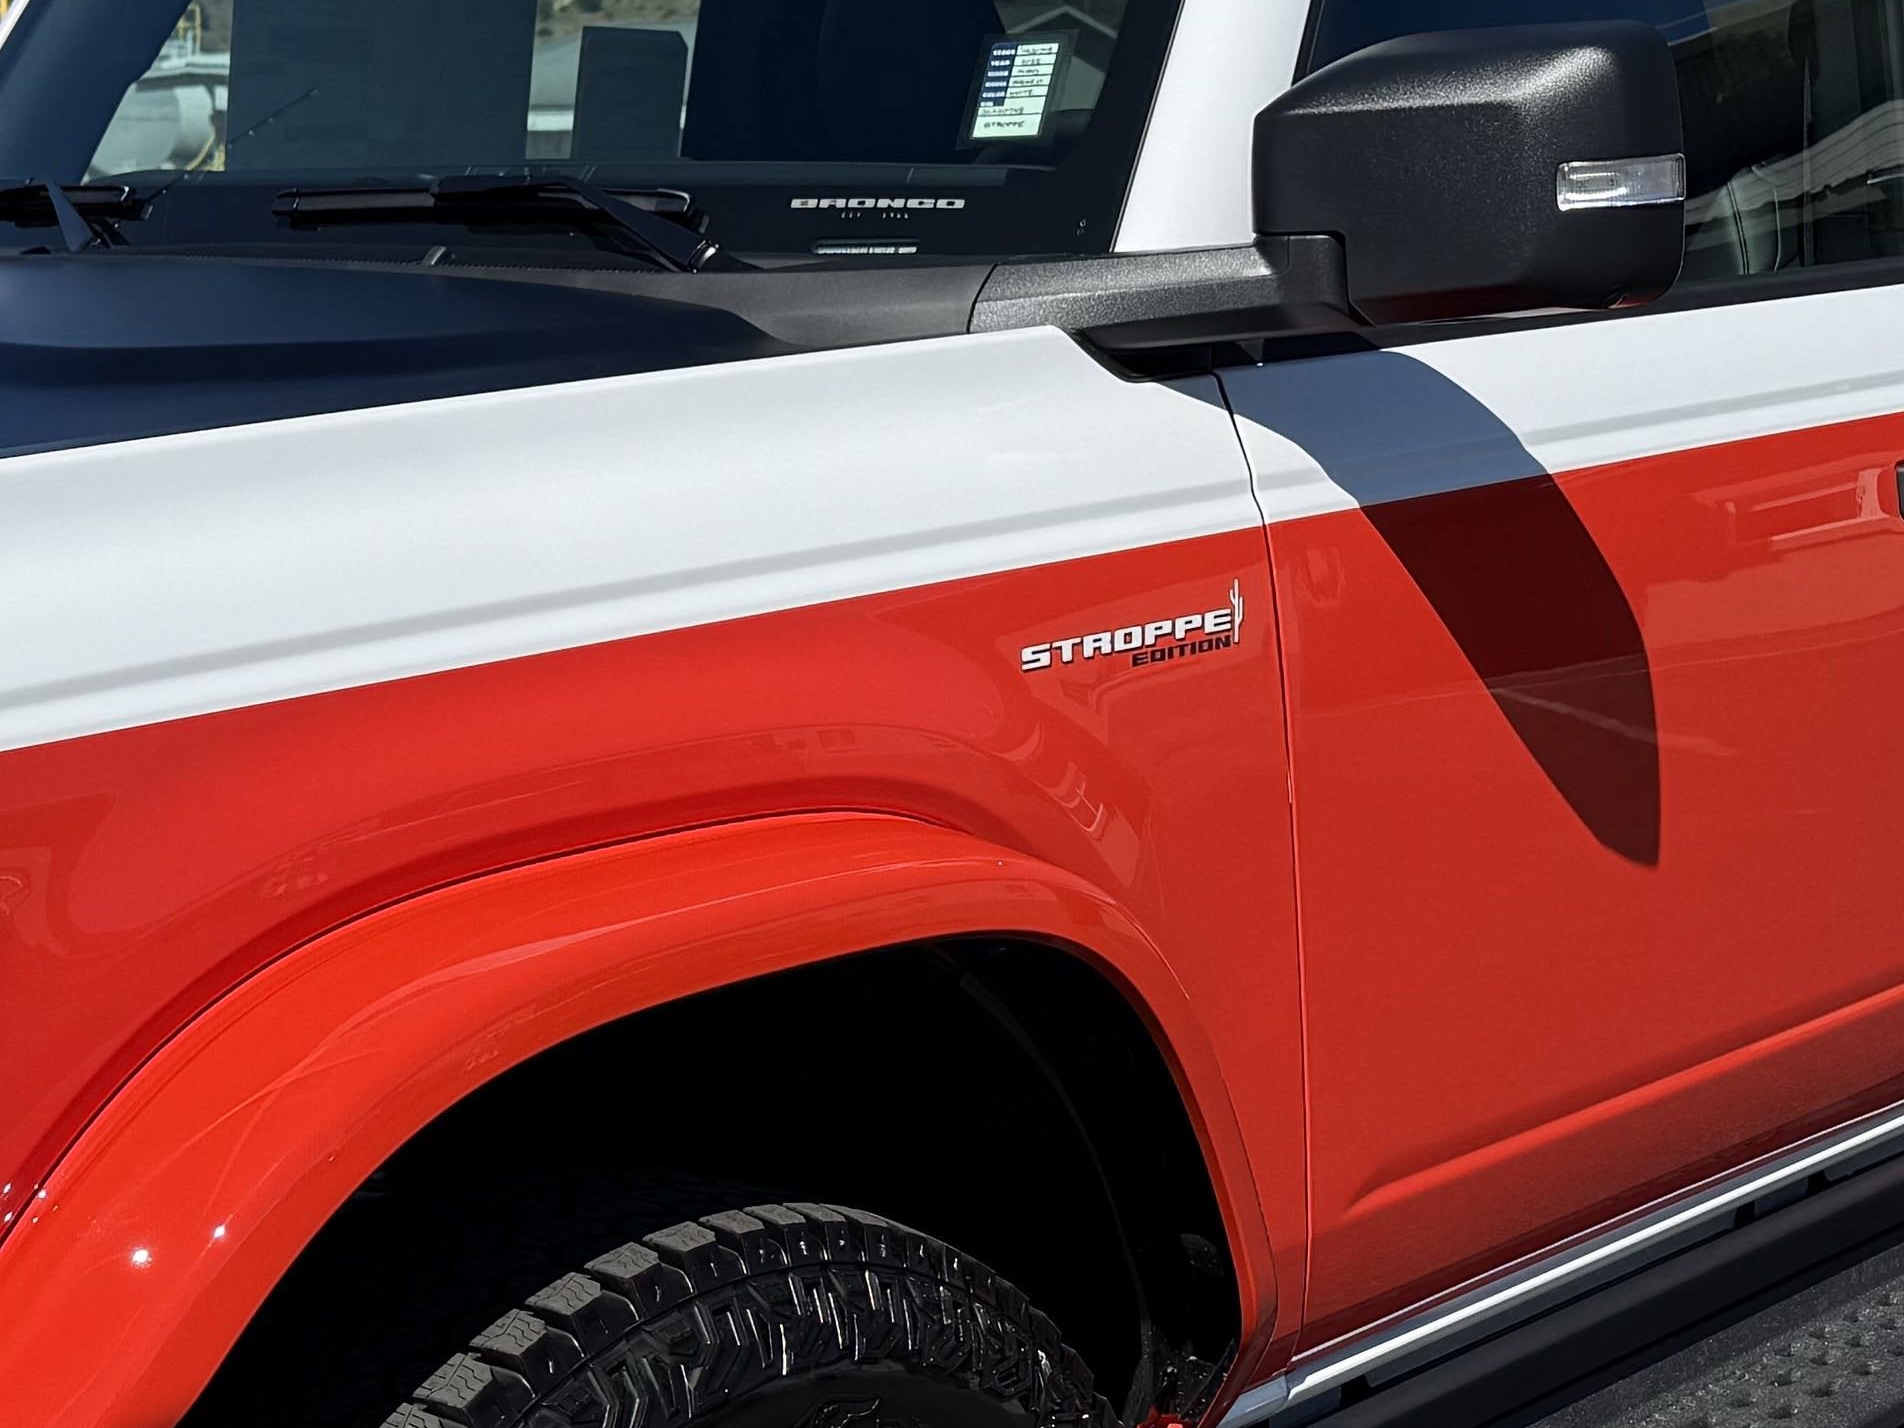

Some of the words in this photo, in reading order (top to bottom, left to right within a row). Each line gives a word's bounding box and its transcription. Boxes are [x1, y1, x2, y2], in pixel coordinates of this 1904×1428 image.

[790, 198, 966, 209] BRONCO
[1021, 608, 1232, 671] STROPPE
[1131, 634, 1232, 668] EDITION
